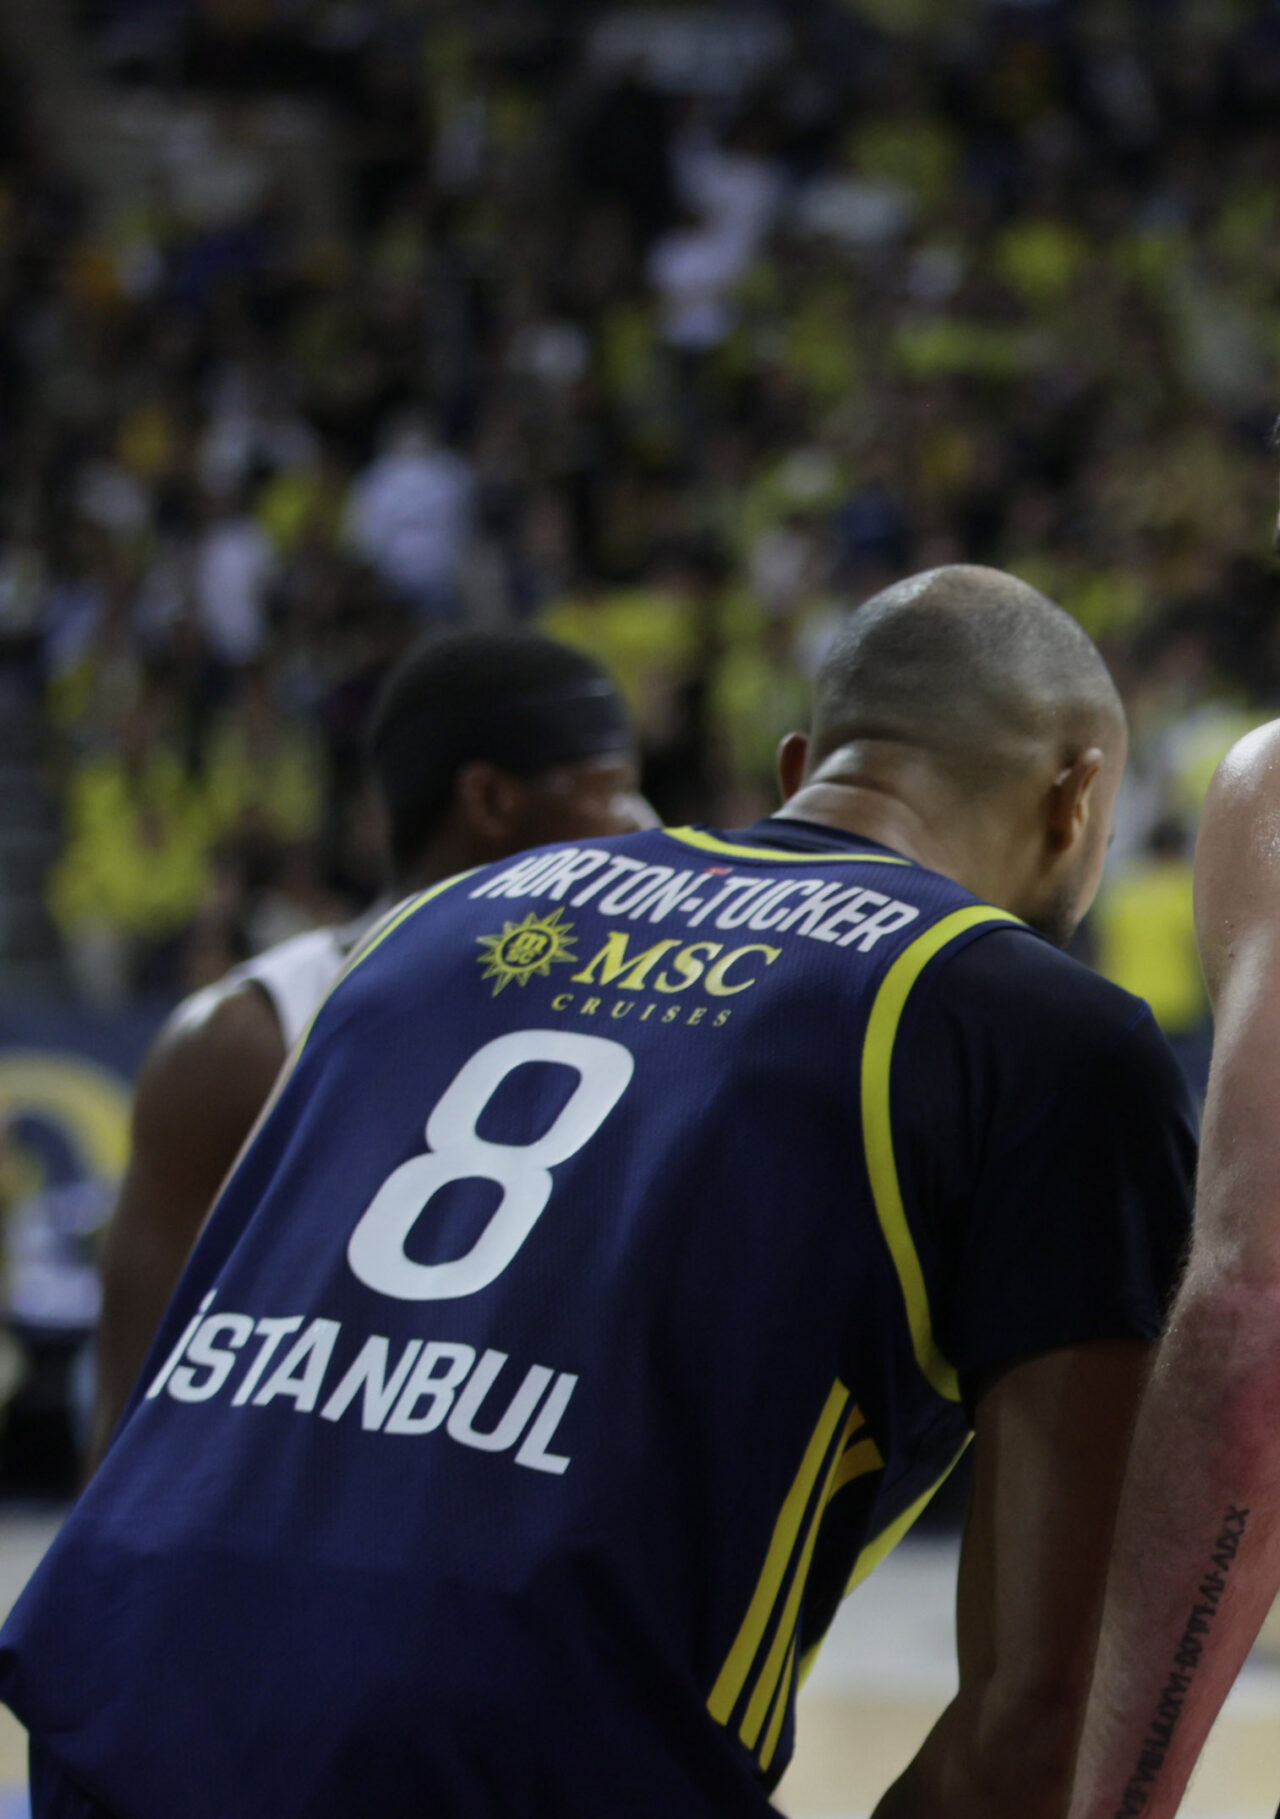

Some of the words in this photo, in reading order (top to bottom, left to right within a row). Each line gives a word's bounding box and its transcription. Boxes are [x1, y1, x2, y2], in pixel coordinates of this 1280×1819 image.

[469, 848, 919, 953] HORTON-TUCKER
[571, 931, 782, 996] MSC
[552, 994, 731, 1027] CRUISES
[347, 1029, 634, 1300] 8
